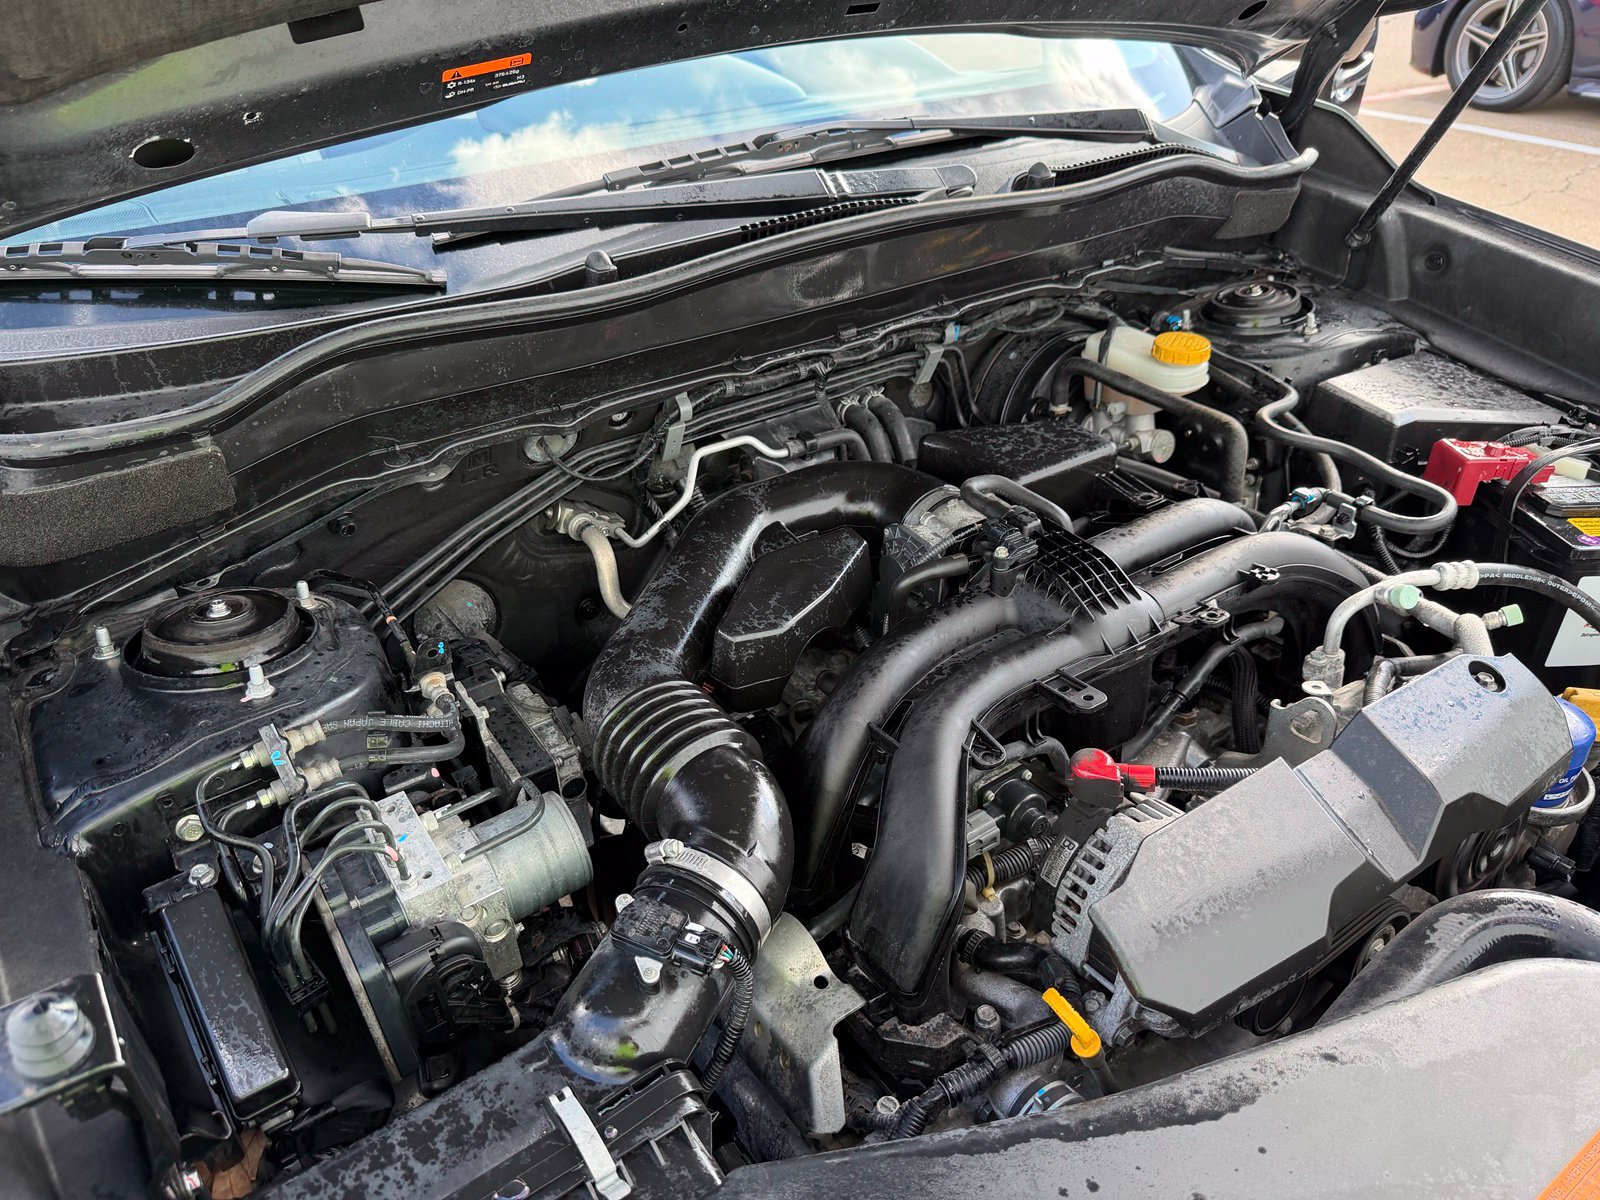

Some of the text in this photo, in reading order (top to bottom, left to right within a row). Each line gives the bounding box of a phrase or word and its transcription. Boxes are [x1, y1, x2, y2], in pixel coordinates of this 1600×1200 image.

[502, 79, 526, 87] SUBARU
[343, 717, 374, 728] JAPAN
[381, 719, 411, 728] CABLE
[417, 719, 454, 729] HITACHI
